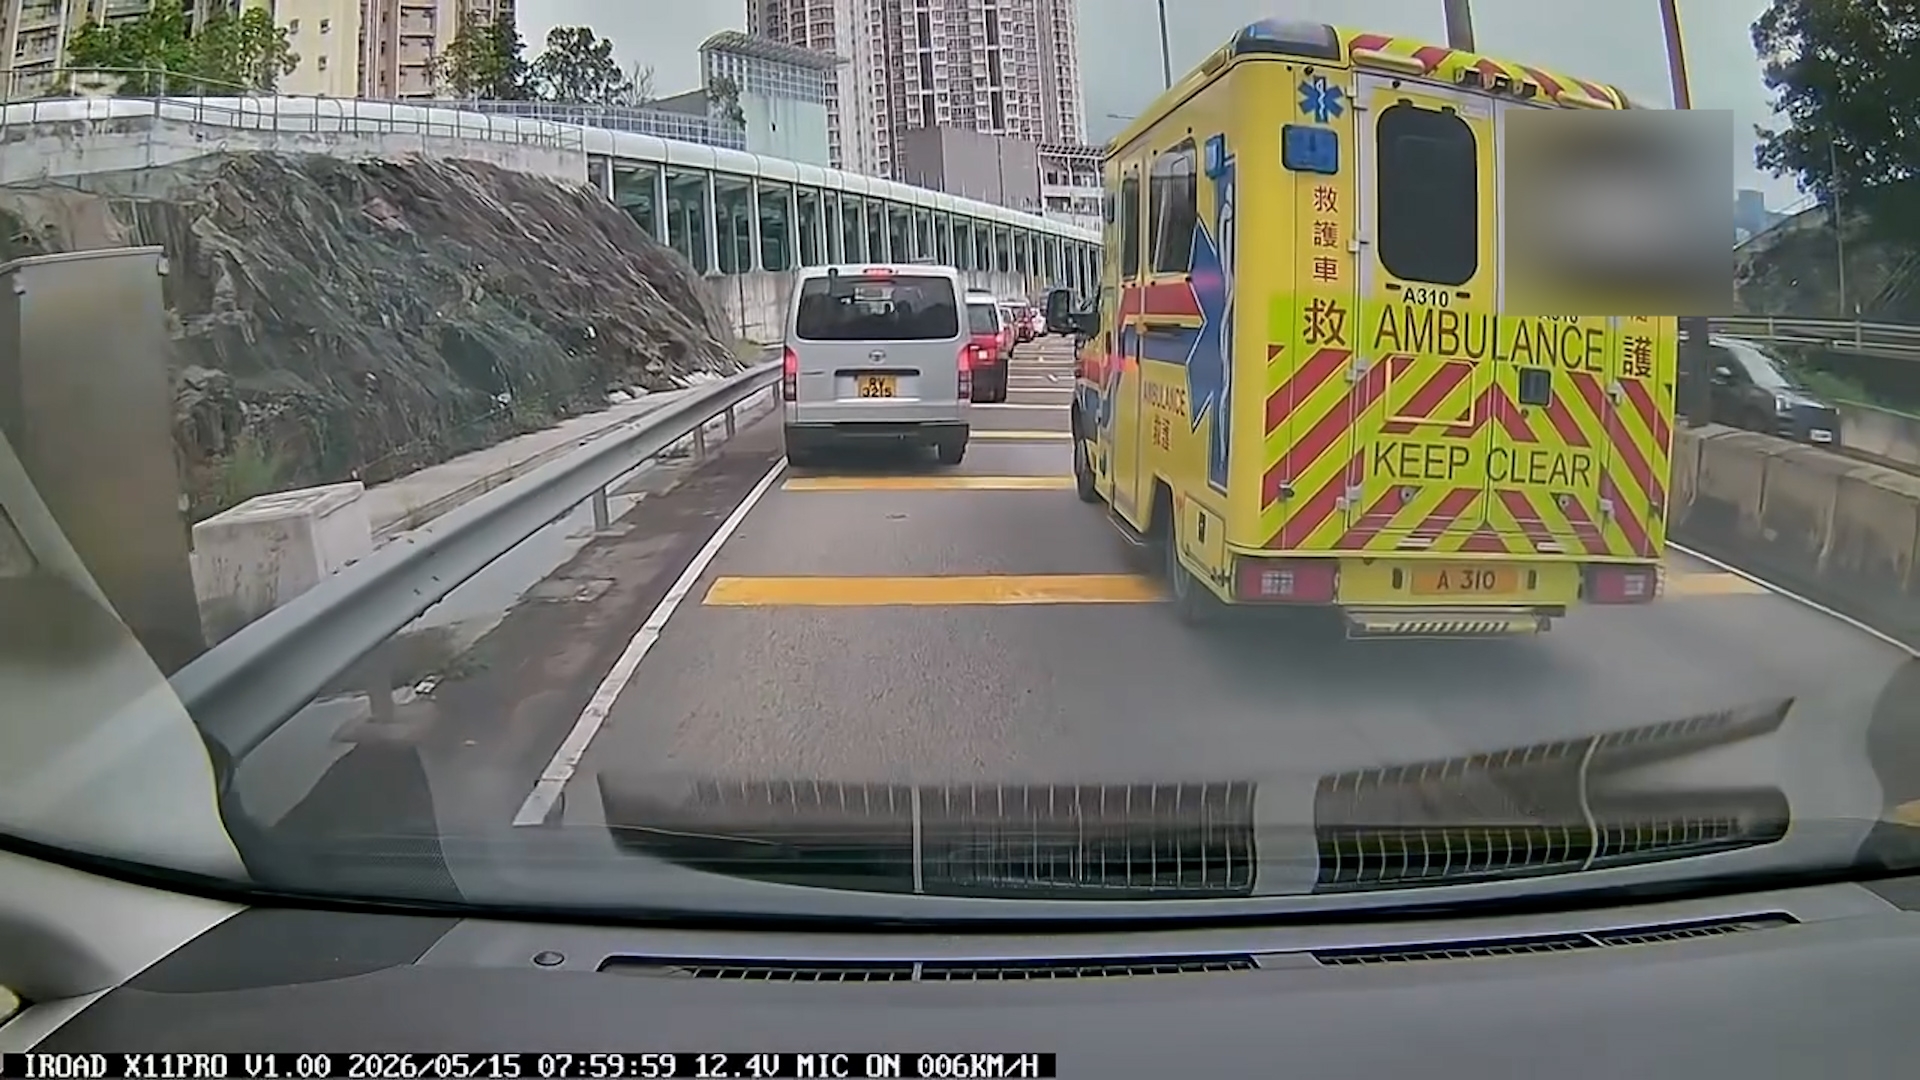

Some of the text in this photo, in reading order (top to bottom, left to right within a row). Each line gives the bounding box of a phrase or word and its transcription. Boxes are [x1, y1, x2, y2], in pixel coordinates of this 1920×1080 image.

[1313, 185, 1339, 283] 救護車
[1402, 286, 1450, 308] A310
[1303, 297, 1347, 346] 救
[1373, 303, 1604, 373] AMBULANCE
[1622, 335, 1652, 378] 護
[1373, 440, 1591, 488] KEEP CLEAR
[1436, 569, 1496, 590] A 310
